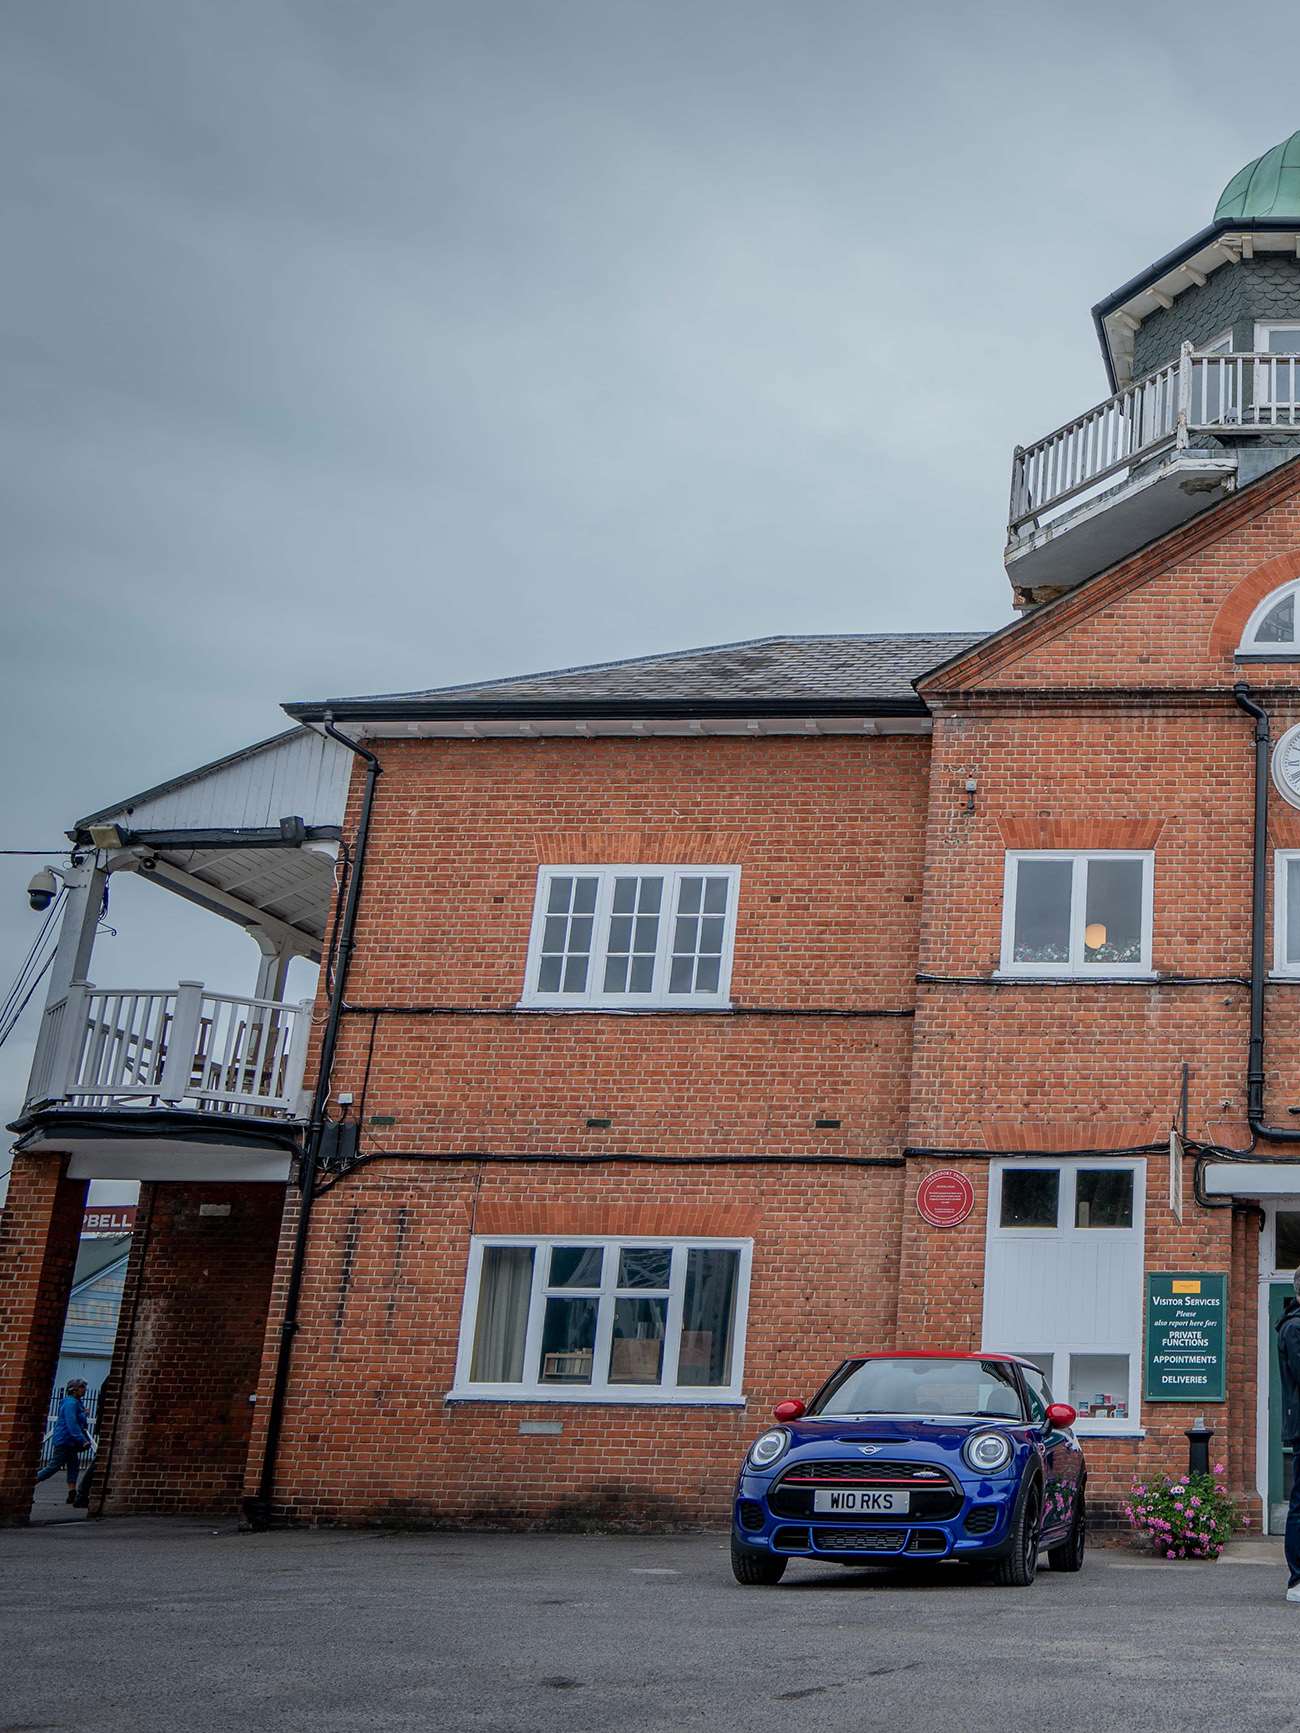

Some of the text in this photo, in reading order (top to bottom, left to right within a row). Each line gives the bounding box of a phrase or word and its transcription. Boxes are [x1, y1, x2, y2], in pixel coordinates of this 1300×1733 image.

[1175, 1310, 1197, 1318] Please
[1168, 1320, 1189, 1328] report
[1189, 1319, 1203, 1327] here
[1169, 1331, 1202, 1339] PRIVATE
[1162, 1338, 1209, 1346] FUNCTIONS
[1153, 1355, 1217, 1364] APPOINTMENTS
[1162, 1375, 1208, 1384] DELIVERIES
[831, 1493, 893, 1509] W10 RKS
